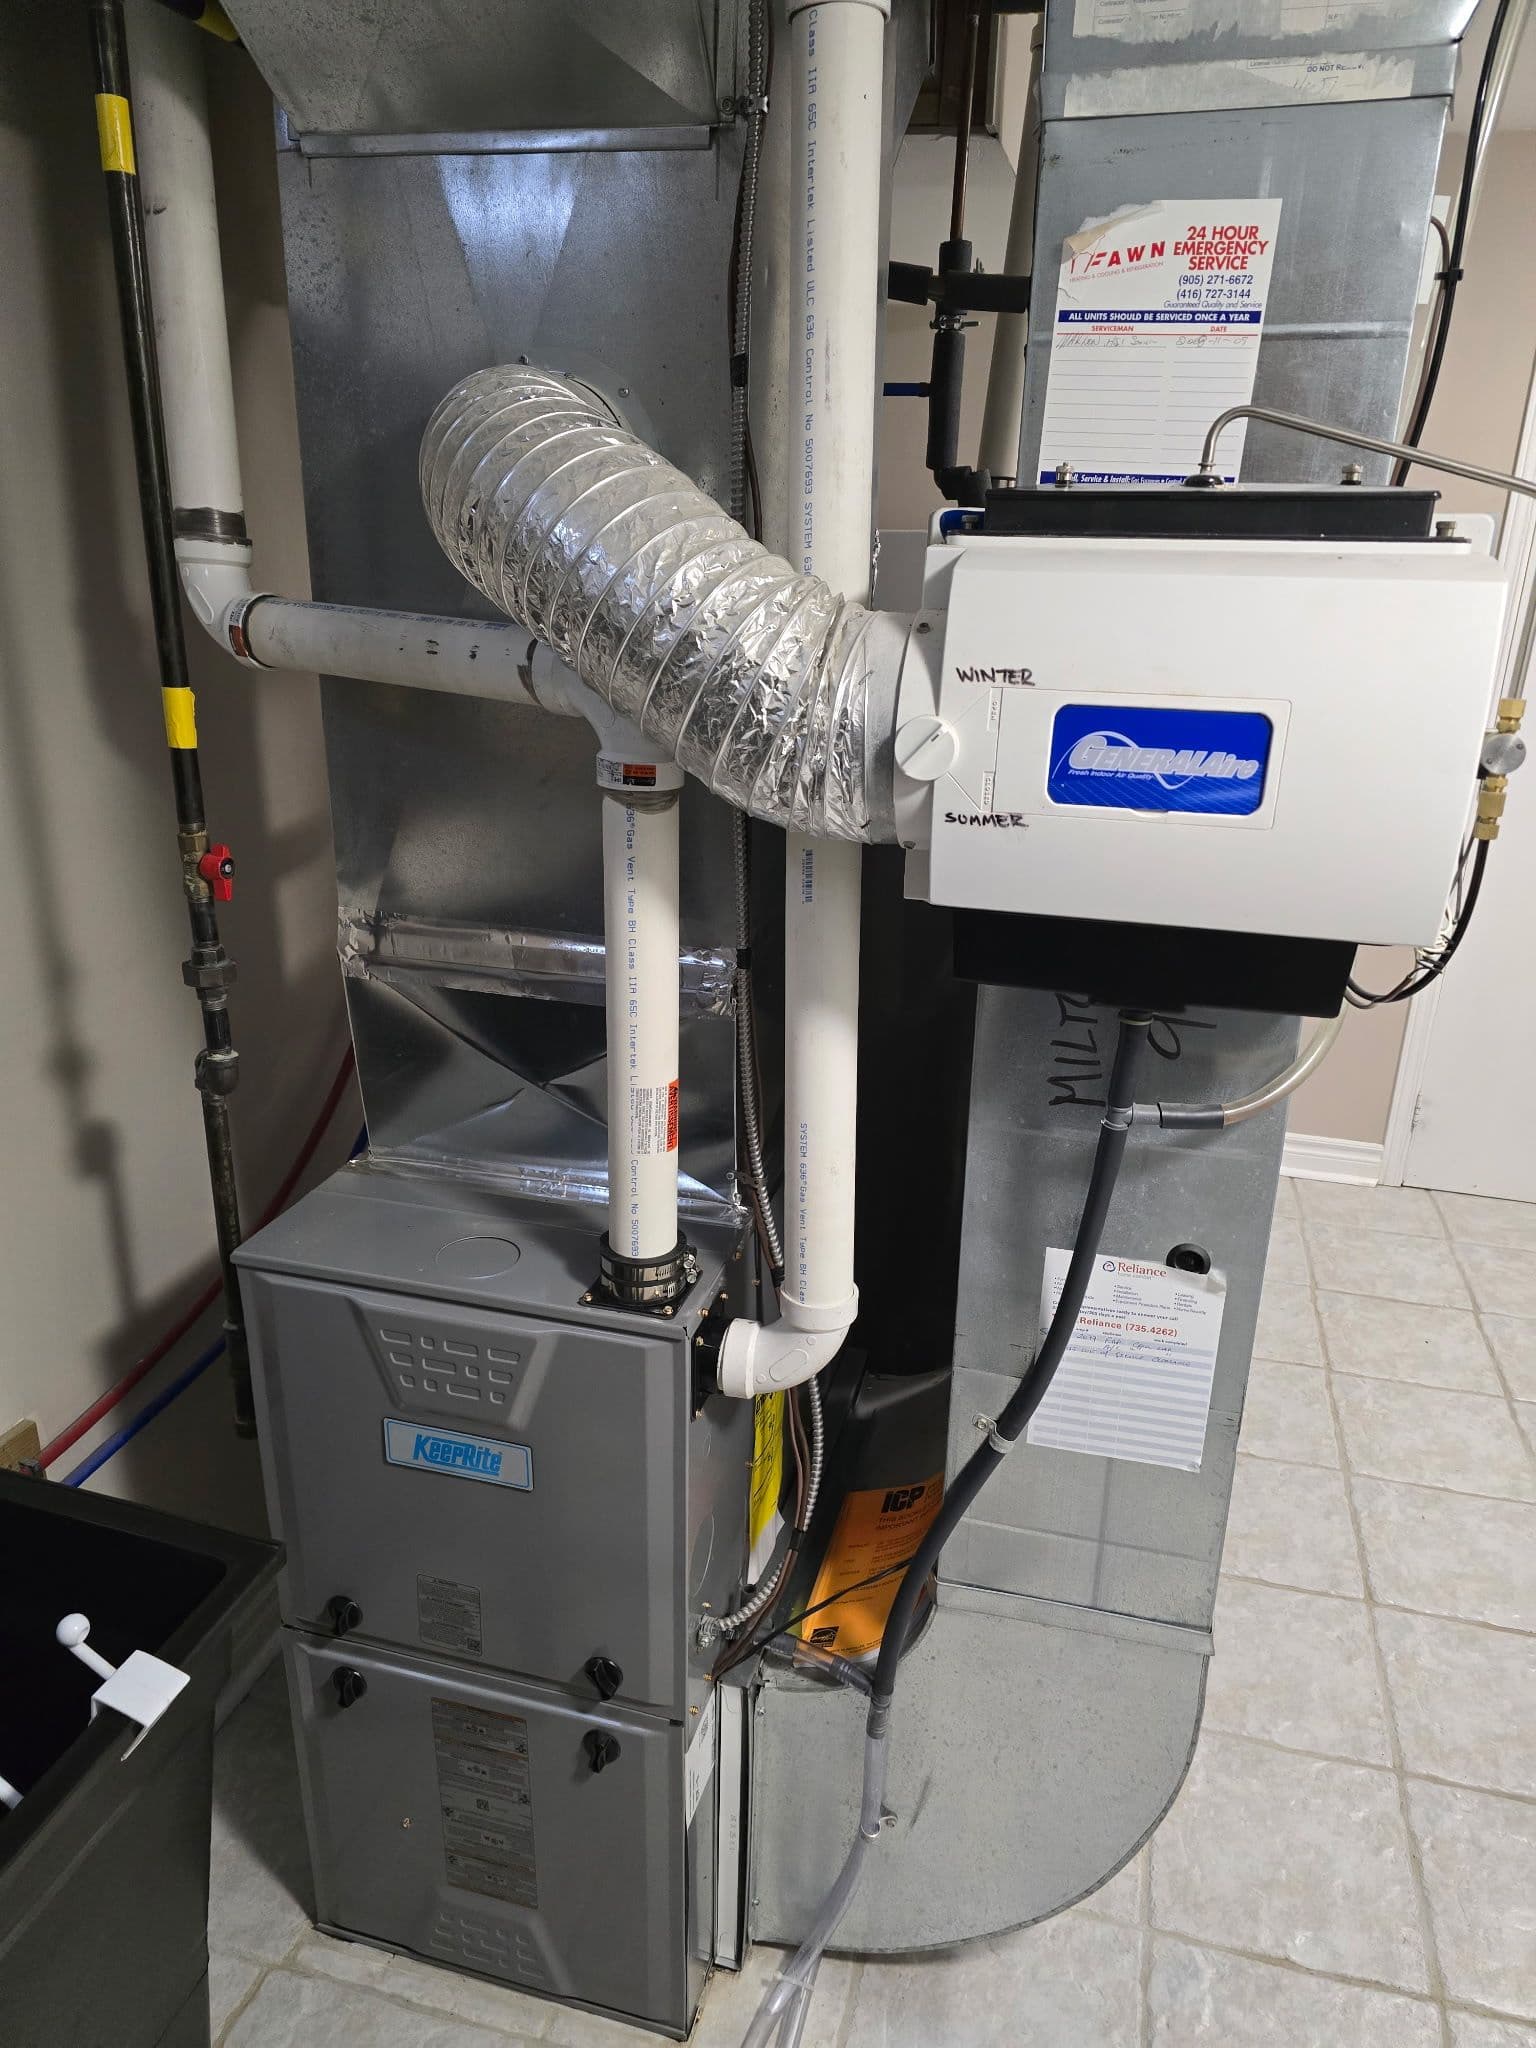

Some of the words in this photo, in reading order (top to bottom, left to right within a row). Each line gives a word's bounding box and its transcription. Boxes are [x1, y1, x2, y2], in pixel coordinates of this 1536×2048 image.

[808, 9, 819, 57] Class
[1307, 65, 1318, 74] DO
[1319, 64, 1335, 73] NOT
[806, 140, 817, 211] Intertek
[1186, 226, 1208, 240] 24
[1211, 225, 1260, 240] HOUR
[805, 219, 816, 273] Listed
[1086, 241, 1166, 270] FAWN
[1173, 240, 1269, 256] EMERGENCY
[1188, 255, 1250, 271] SERVICE
[1178, 274, 1205, 286] (905)
[1206, 274, 1254, 285] 271-6672
[805, 280, 815, 306] ULC
[1176, 288, 1202, 300] (416)
[1205, 288, 1251, 299] 727-3144
[1202, 300, 1224, 310] Quality
[1224, 300, 1239, 308] and
[1240, 300, 1263, 309] Service
[805, 314, 815, 341] 636
[1068, 312, 1083, 320] ALL
[1084, 312, 1108, 321] UNITS
[1109, 312, 1142, 321] SHOULD
[1144, 312, 1155, 321] BE
[1156, 313, 1193, 321] SERVICED
[1194, 313, 1218, 321] ONCE
[1219, 313, 1227, 321] A
[1229, 313, 1251, 322] YEAR
[1091, 325, 1134, 333] SERVICEMAN
[1210, 325, 1228, 333] DATE
[805, 348, 815, 406] Control
[804, 413, 814, 431] No
[804, 438, 813, 495] 5007693
[1081, 473, 1103, 483] Service
[803, 501, 813, 549] SYSTEM
[955, 667, 1035, 686] WINTER
[1067, 769, 1090, 777] Fresh
[1091, 770, 1113, 778] Indoor
[1127, 772, 1154, 781] Quality
[945, 812, 1029, 828] SUMMER
[626, 856, 637, 882] Vent
[626, 888, 637, 914] Type
[627, 920, 637, 933] BH
[627, 939, 638, 970] Class
[629, 1024, 638, 1070] Intertek
[799, 1123, 808, 1158] SYSTEM
[630, 1160, 640, 1198] Control
[630, 1203, 640, 1215] No
[799, 1209, 808, 1231] Vent
[631, 1219, 640, 1256] 5007693
[798, 1237, 807, 1259] Type
[1117, 1261, 1167, 1278] Reliance
[1079, 1316, 1122, 1330] Reliance
[1125, 1321, 1178, 1338] (735.4262)
[881, 1485, 926, 1514] ICP
